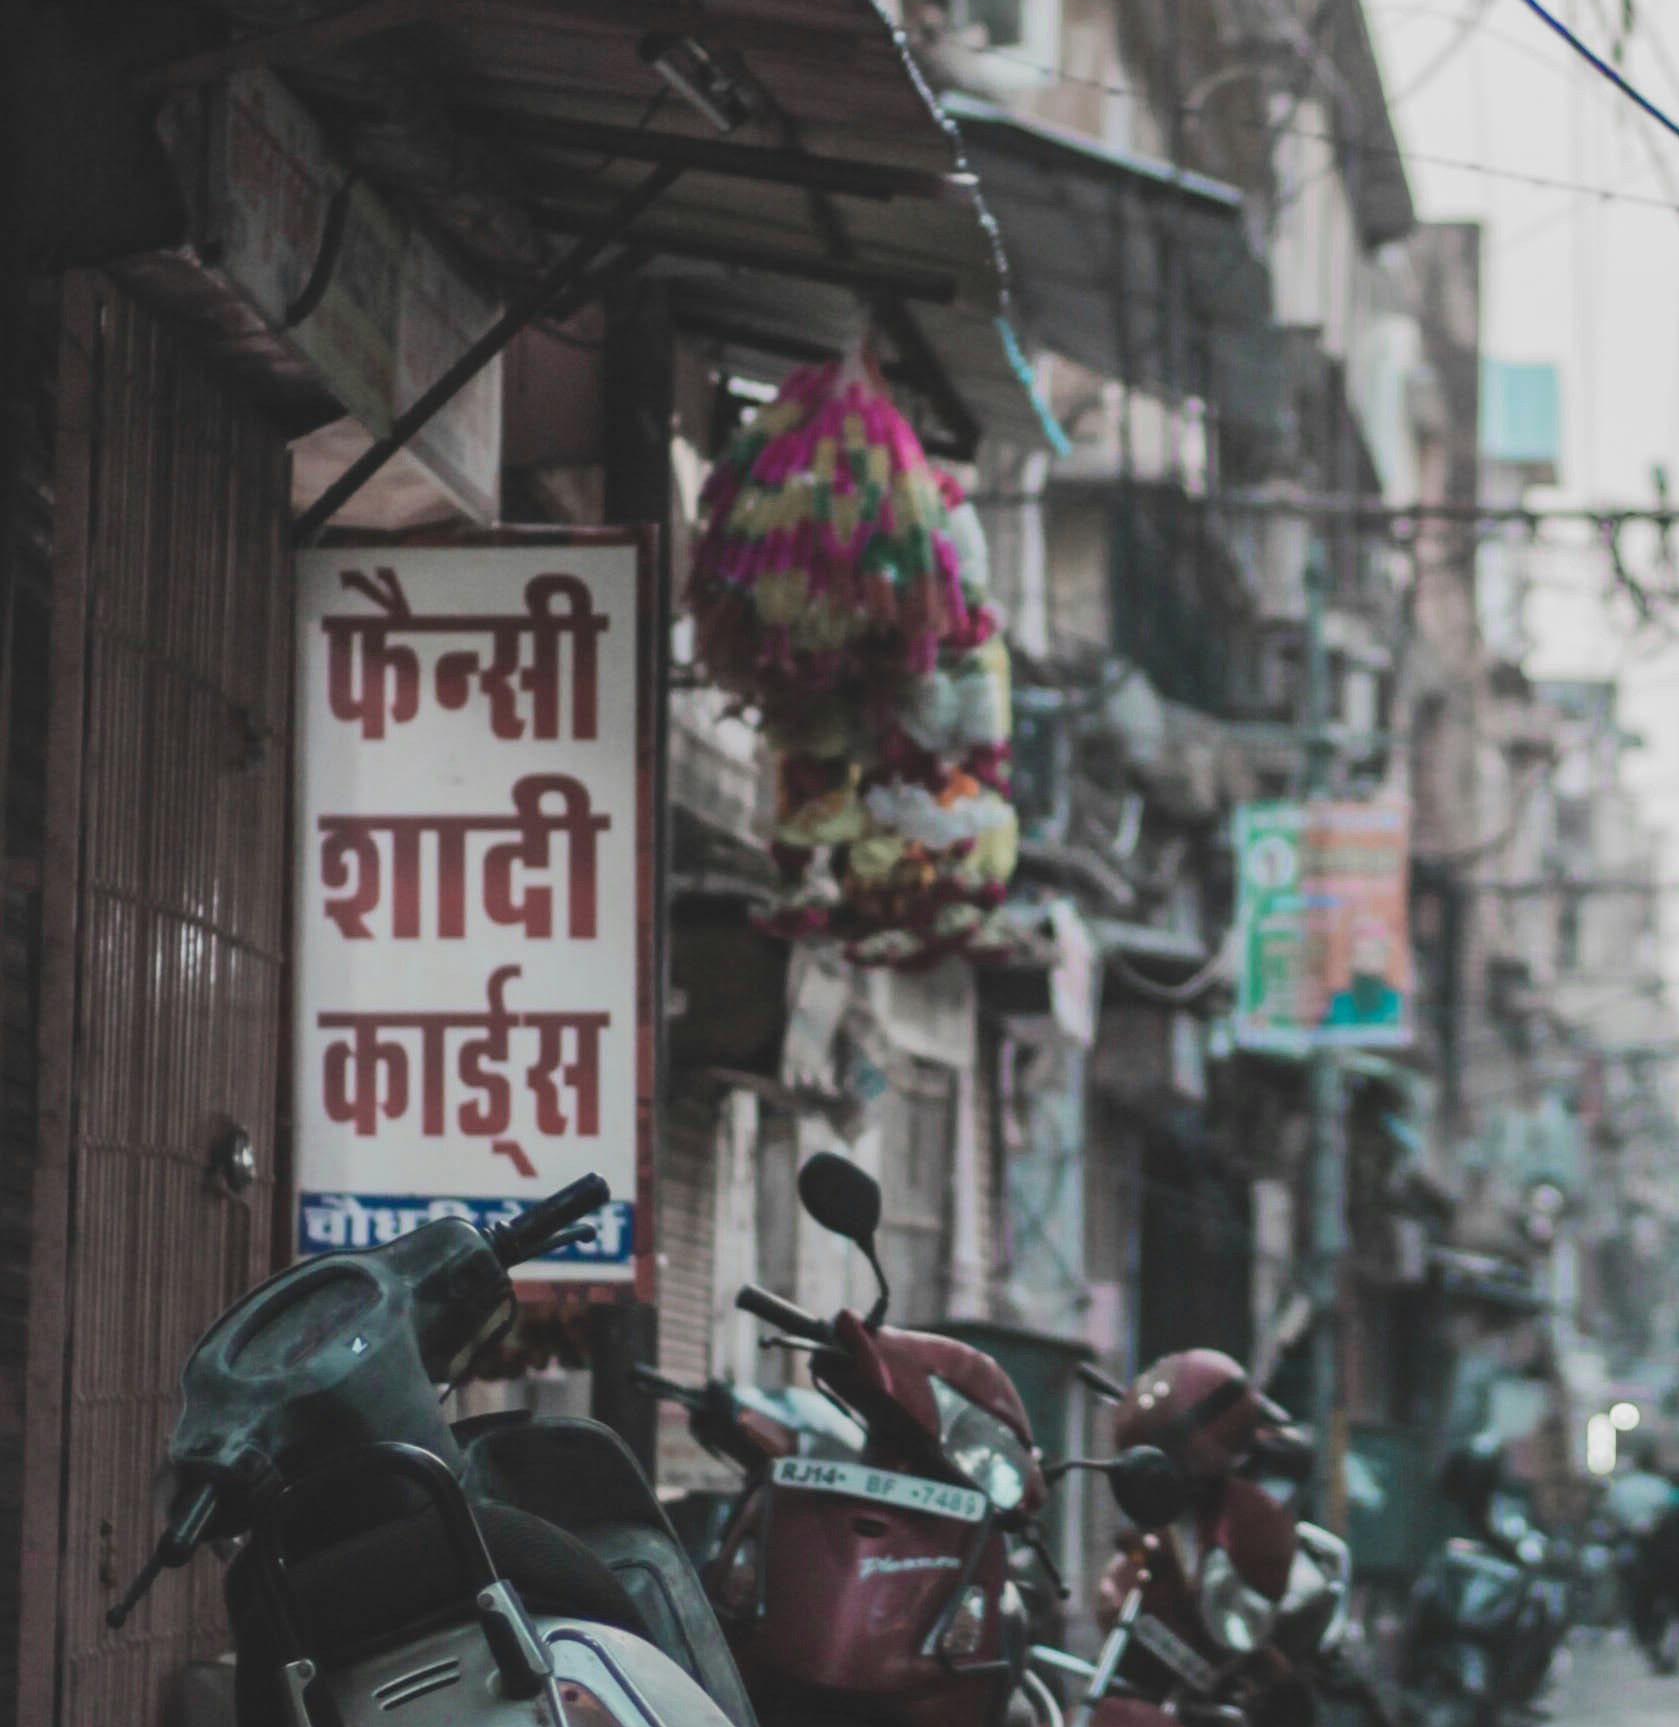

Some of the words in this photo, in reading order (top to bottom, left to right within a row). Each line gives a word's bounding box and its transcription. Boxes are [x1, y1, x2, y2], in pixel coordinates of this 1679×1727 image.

[320, 566, 611, 742] फैन्सी
[317, 773, 611, 941] शादी
[317, 965, 611, 1179] कार्ड्स
